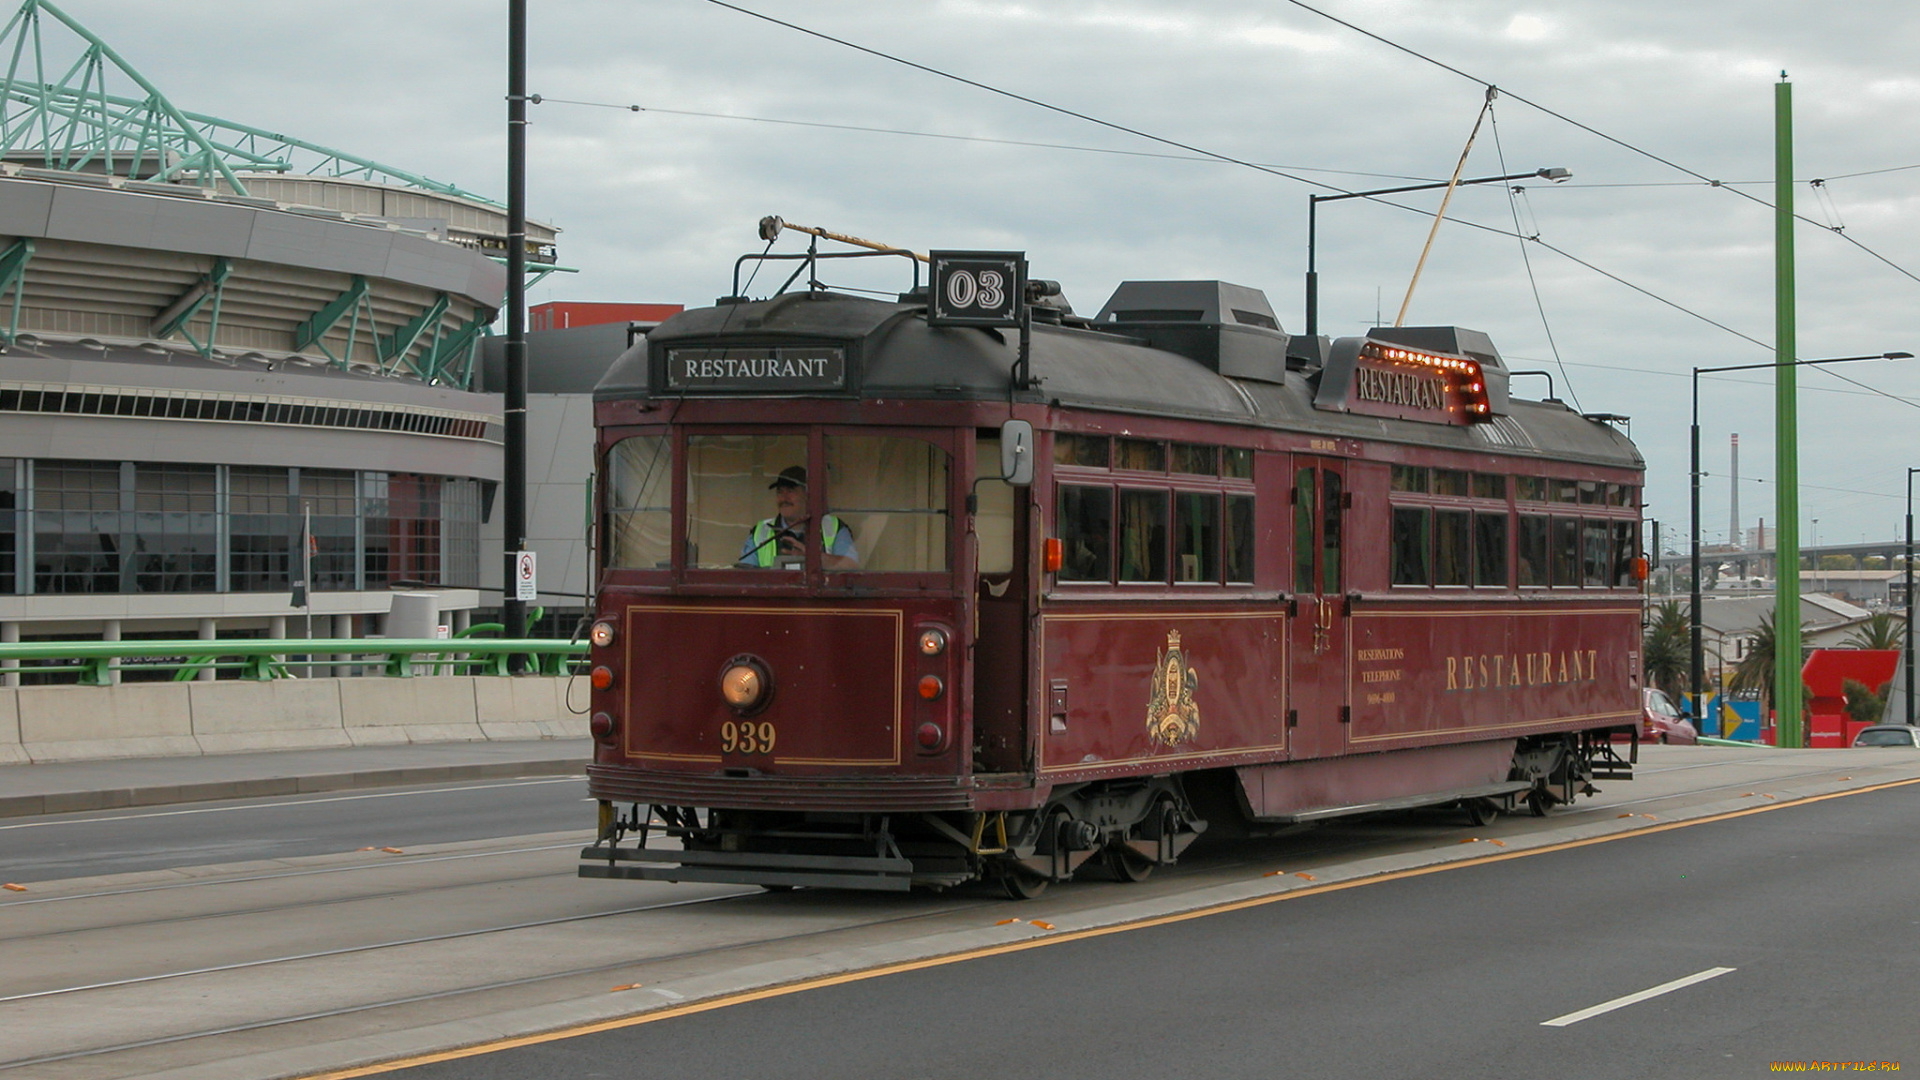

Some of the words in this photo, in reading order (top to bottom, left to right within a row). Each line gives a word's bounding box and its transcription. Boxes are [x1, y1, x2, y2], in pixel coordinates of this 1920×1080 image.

[946, 269, 1005, 310] 03
[685, 358, 829, 378] RESTAURANT
[1358, 366, 1449, 411] RESTAURANT
[1357, 648, 1405, 661] RESERVATIONS
[1446, 649, 1598, 691] RESTAURANT
[1362, 669, 1402, 683] TELEPHONE
[721, 721, 777, 754] 939
